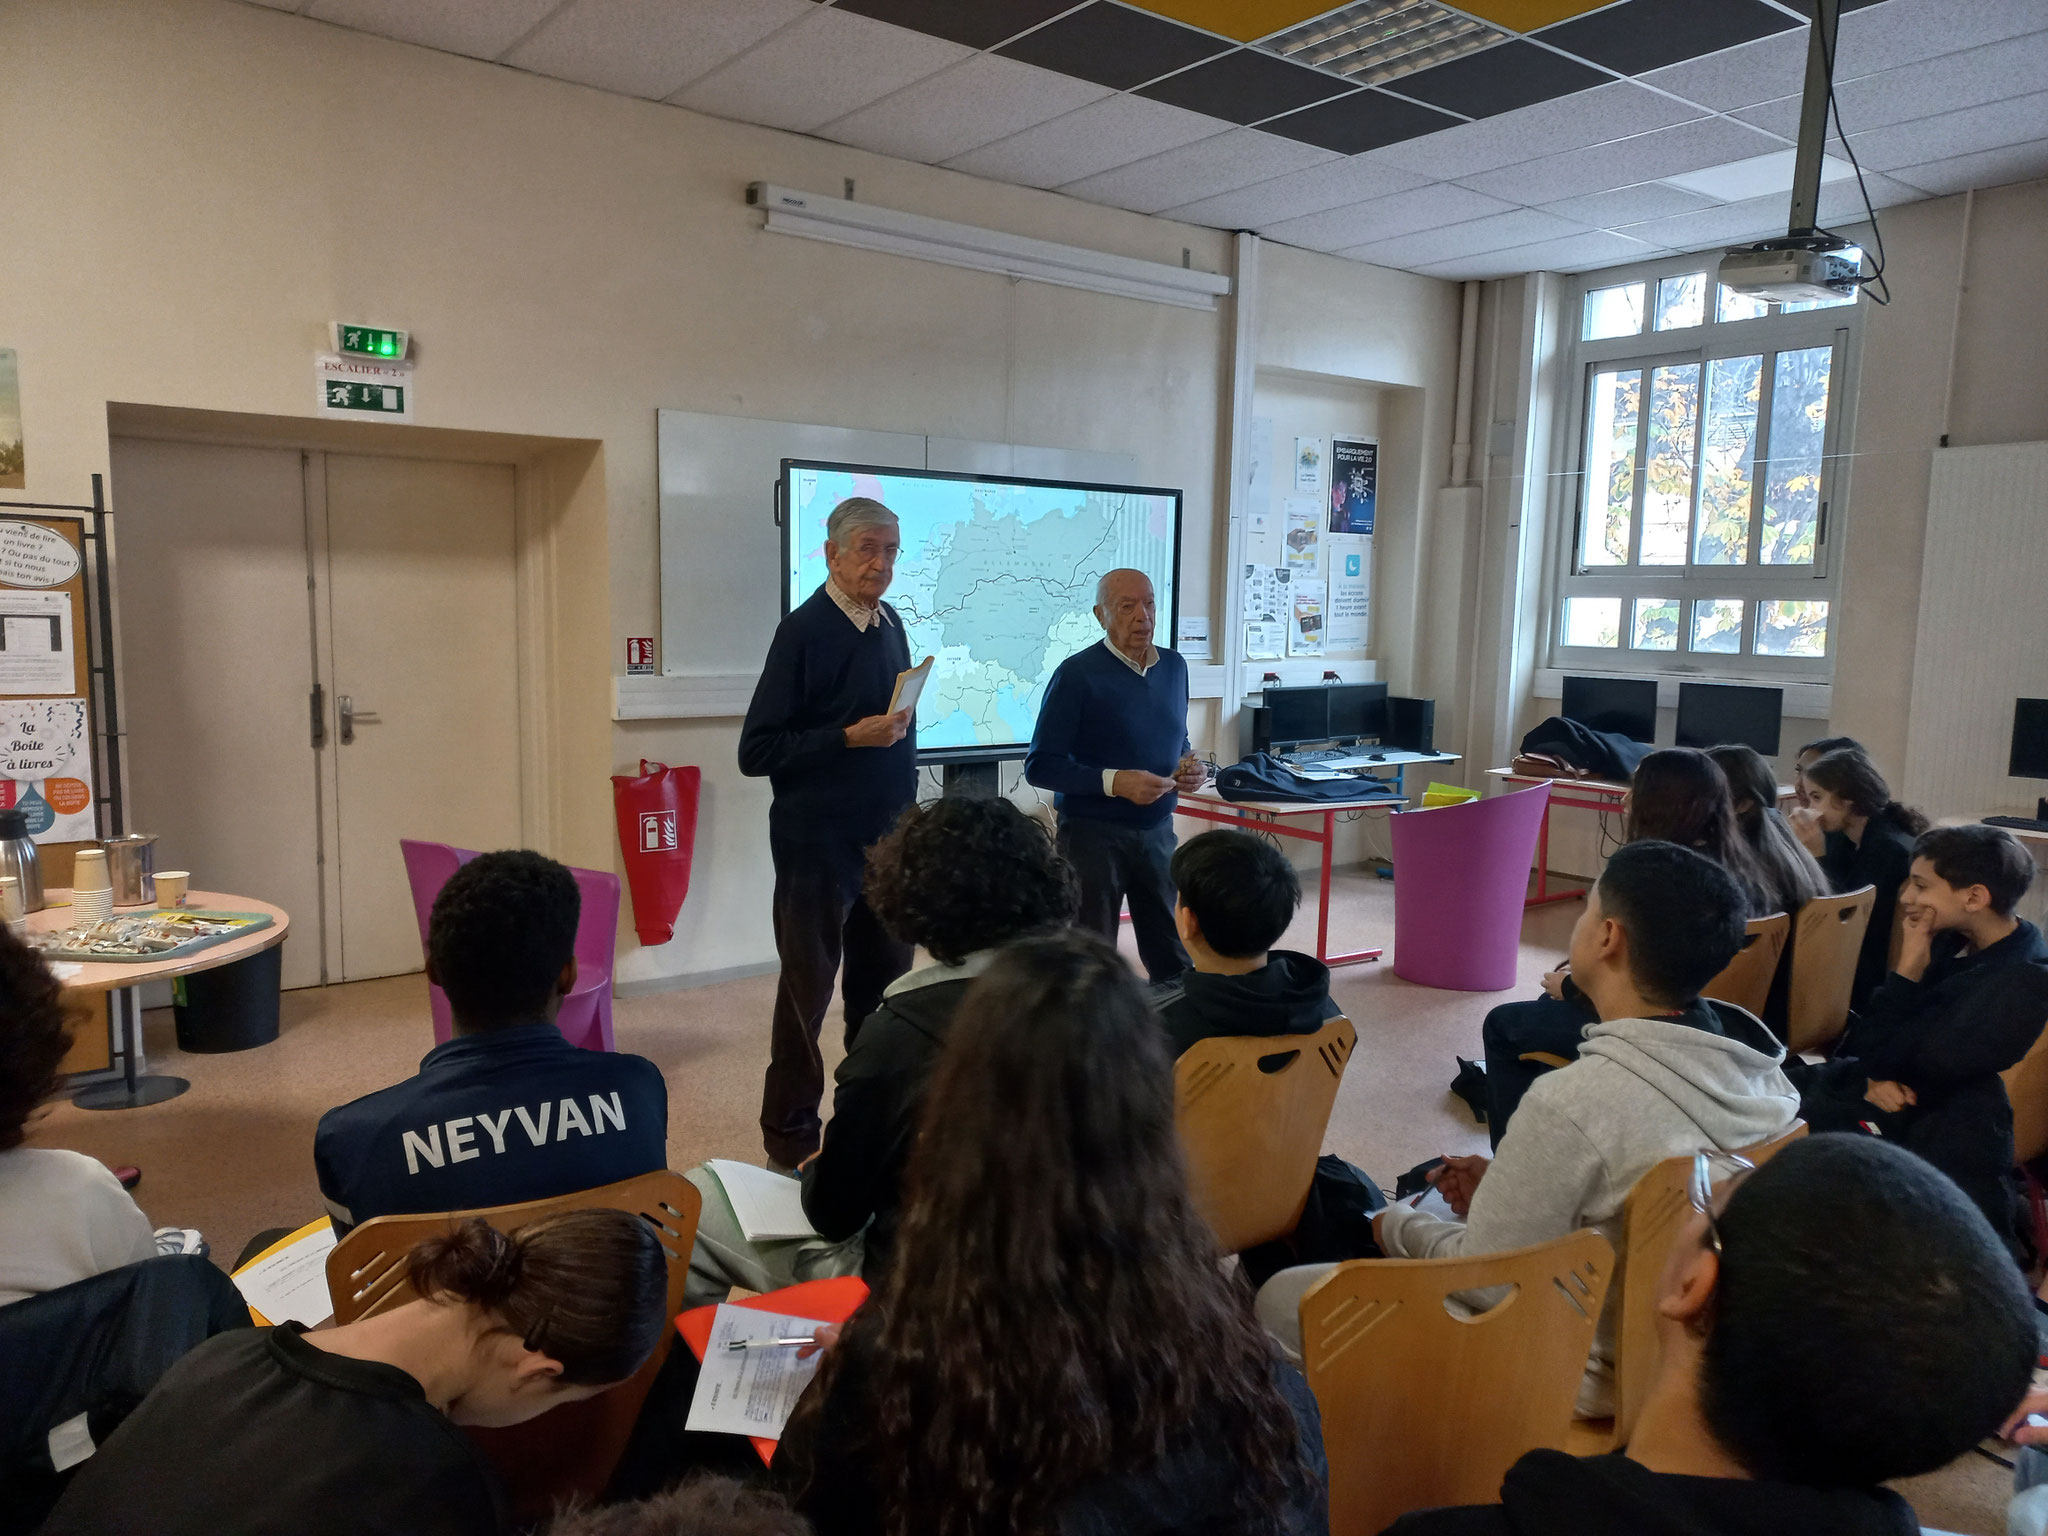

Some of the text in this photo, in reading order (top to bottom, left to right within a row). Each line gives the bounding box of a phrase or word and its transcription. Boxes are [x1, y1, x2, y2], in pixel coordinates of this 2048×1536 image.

[324, 362, 381, 376] ESCALIER
[392, 368, 396, 377] 2
[1336, 446, 1374, 456] EMBARQUEMENT
[6, 529, 28, 538] viens
[42, 535, 56, 544] lire
[16, 540, 36, 550] livre
[8, 549, 20, 557] Ou
[52, 558, 70, 566] tout
[25, 564, 46, 572] nous
[20, 722, 36, 736] La
[6, 758, 53, 770] à livres
[402, 1092, 626, 1176] NEYVAN
